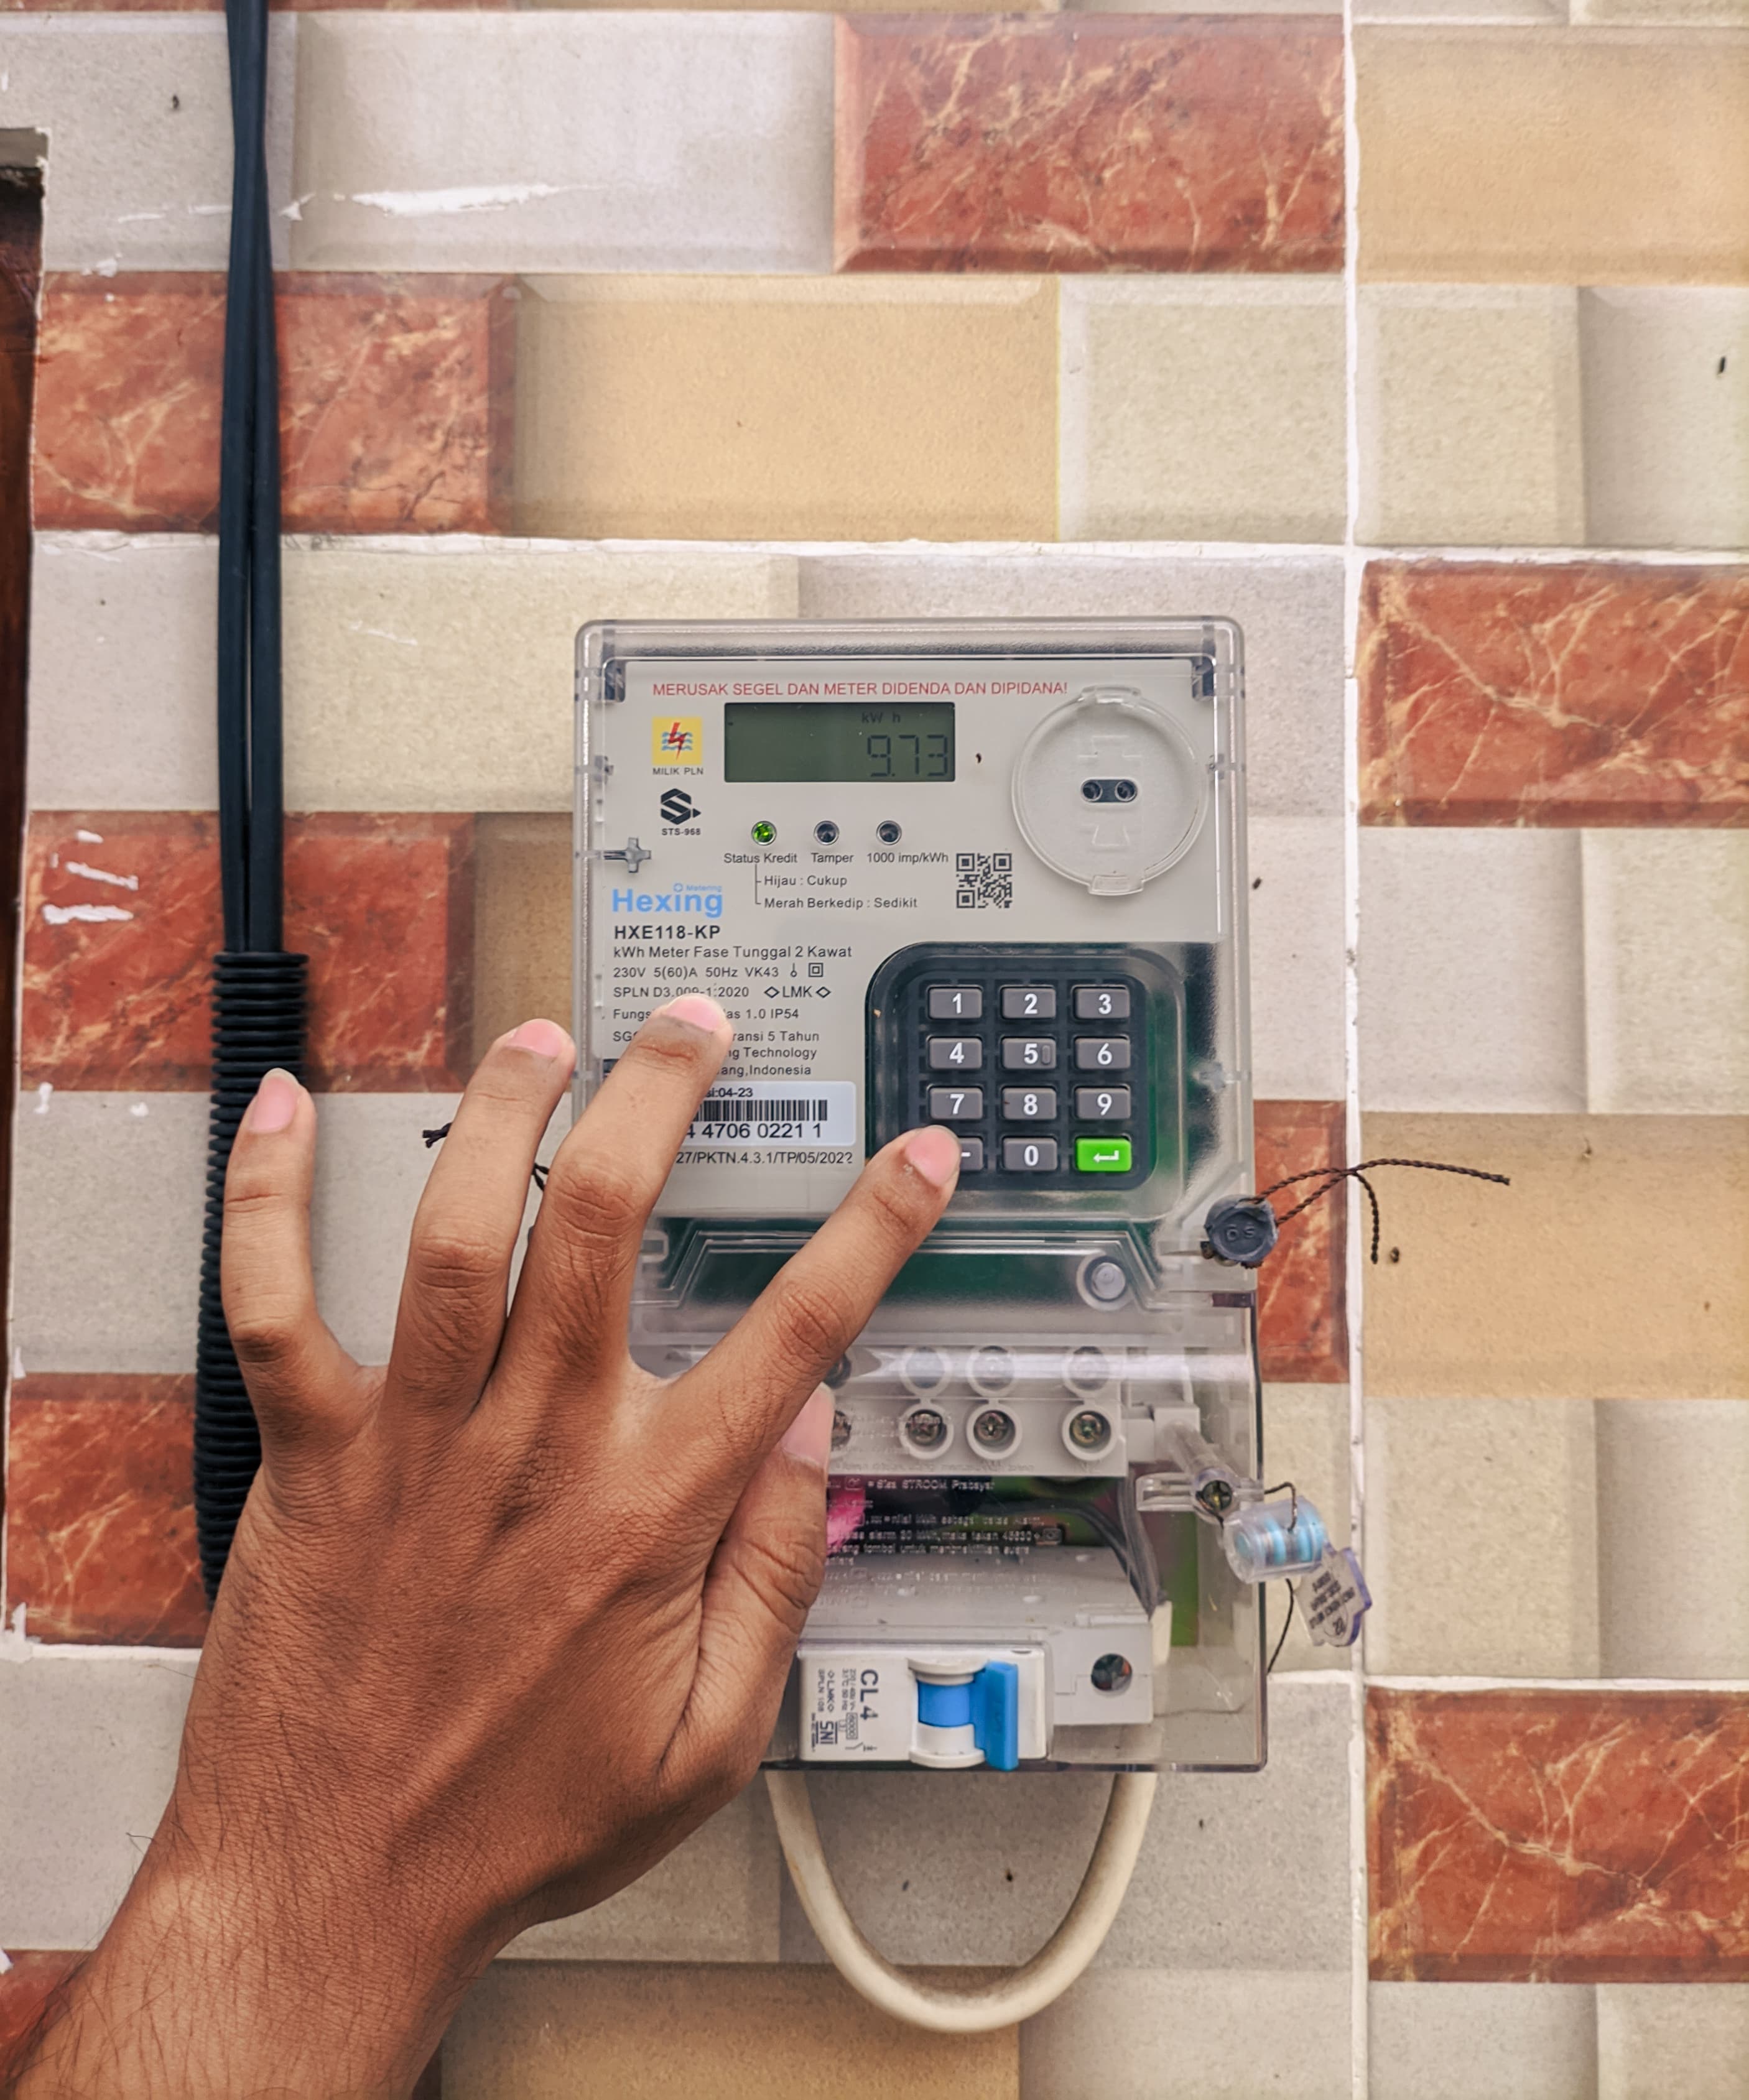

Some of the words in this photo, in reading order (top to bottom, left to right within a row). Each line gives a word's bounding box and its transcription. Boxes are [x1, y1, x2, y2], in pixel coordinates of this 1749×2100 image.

[654, 684, 729, 696] MERUSAK
[733, 683, 784, 696] SEGEL
[788, 683, 820, 696] DAN
[825, 683, 878, 696] METER
[883, 683, 952, 695] DIDENDA
[955, 683, 986, 695] DAN
[991, 682, 1068, 695] DIPIDANA!
[866, 734, 949, 778] 9.73
[653, 768, 680, 776] MILIK
[684, 767, 704, 776] PLN
[662, 828, 702, 836] STS-968
[725, 853, 761, 864] Status
[764, 853, 797, 864] Kredit
[812, 853, 854, 865] Tamper
[868, 853, 896, 864] 1000
[899, 853, 949, 865] imp/kWh
[765, 876, 797, 889] Hijau
[807, 876, 848, 888] Cukup
[612, 888, 723, 918] Hexing
[765, 898, 804, 909] Merah
[808, 898, 864, 911] Berkedip
[874, 898, 917, 909] Sedikit
[615, 925, 721, 940] HXE118-KP
[615, 947, 645, 958] kWh
[649, 946, 690, 958] Meter
[694, 946, 730, 958] Fase
[734, 946, 792, 961] Tunggal
[796, 946, 804, 958] 2
[808, 946, 852, 958] Kawat
[614, 968, 646, 979] 230V
[654, 966, 698, 981] 5(60)A
[707, 968, 738, 978] 50Hz
[745, 967, 779, 978] VK43
[615, 988, 649, 998] SPLN
[783, 986, 812, 998] LMK
[953, 993, 962, 1014] 1
[1025, 994, 1038, 1015] 2
[1099, 994, 1112, 1015] 3
[746, 1009, 767, 1020] 1.0
[771, 1009, 799, 1020] IP54
[768, 1031, 776, 1042] 5
[781, 1031, 820, 1042] Tahun
[743, 1047, 817, 1061] Technology
[949, 1042, 965, 1063] 4
[1024, 1043, 1039, 1065] 5
[1098, 1043, 1113, 1066] 6
[950, 1093, 965, 1114] 7
[1024, 1094, 1039, 1116] 8
[1097, 1093, 1112, 1116] 9
[702, 1124, 751, 1139] 4706
[758, 1124, 802, 1139] 0221
[814, 1123, 821, 1139] 1
[1025, 1145, 1039, 1167] 0
[820, 1721, 834, 1744] SNI
